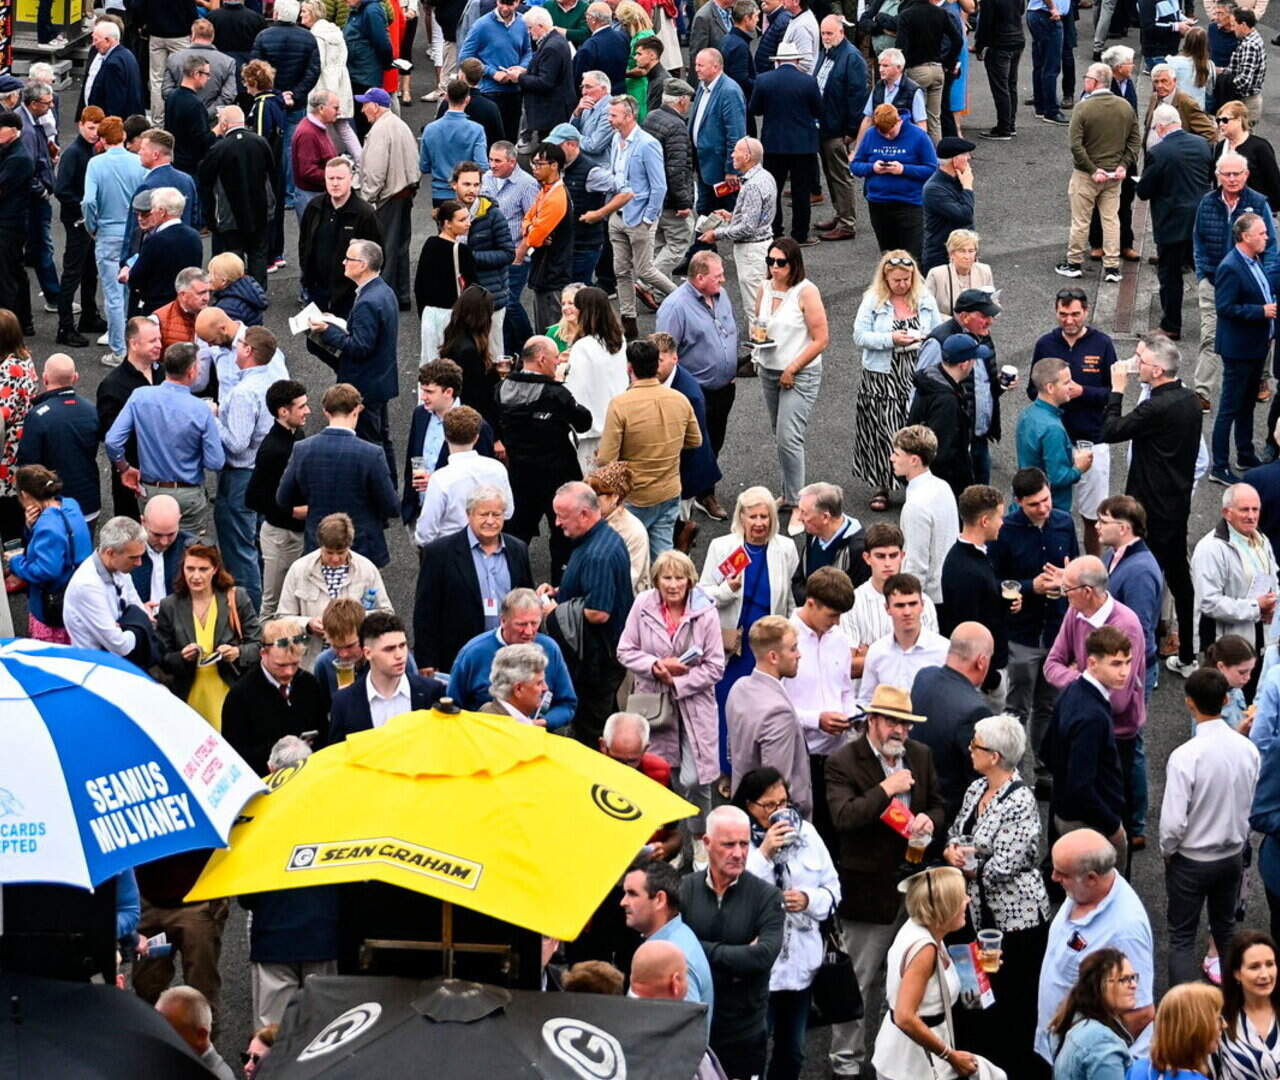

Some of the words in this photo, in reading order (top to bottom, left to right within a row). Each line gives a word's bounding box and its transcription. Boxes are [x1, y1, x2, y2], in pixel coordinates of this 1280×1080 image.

[85, 761, 170, 815] SEAMUS
[0, 822, 47, 837] CARDS
[89, 792, 198, 855] MULVANEY
[321, 845, 376, 862] SEAN
[378, 844, 471, 881] GRAHAM
